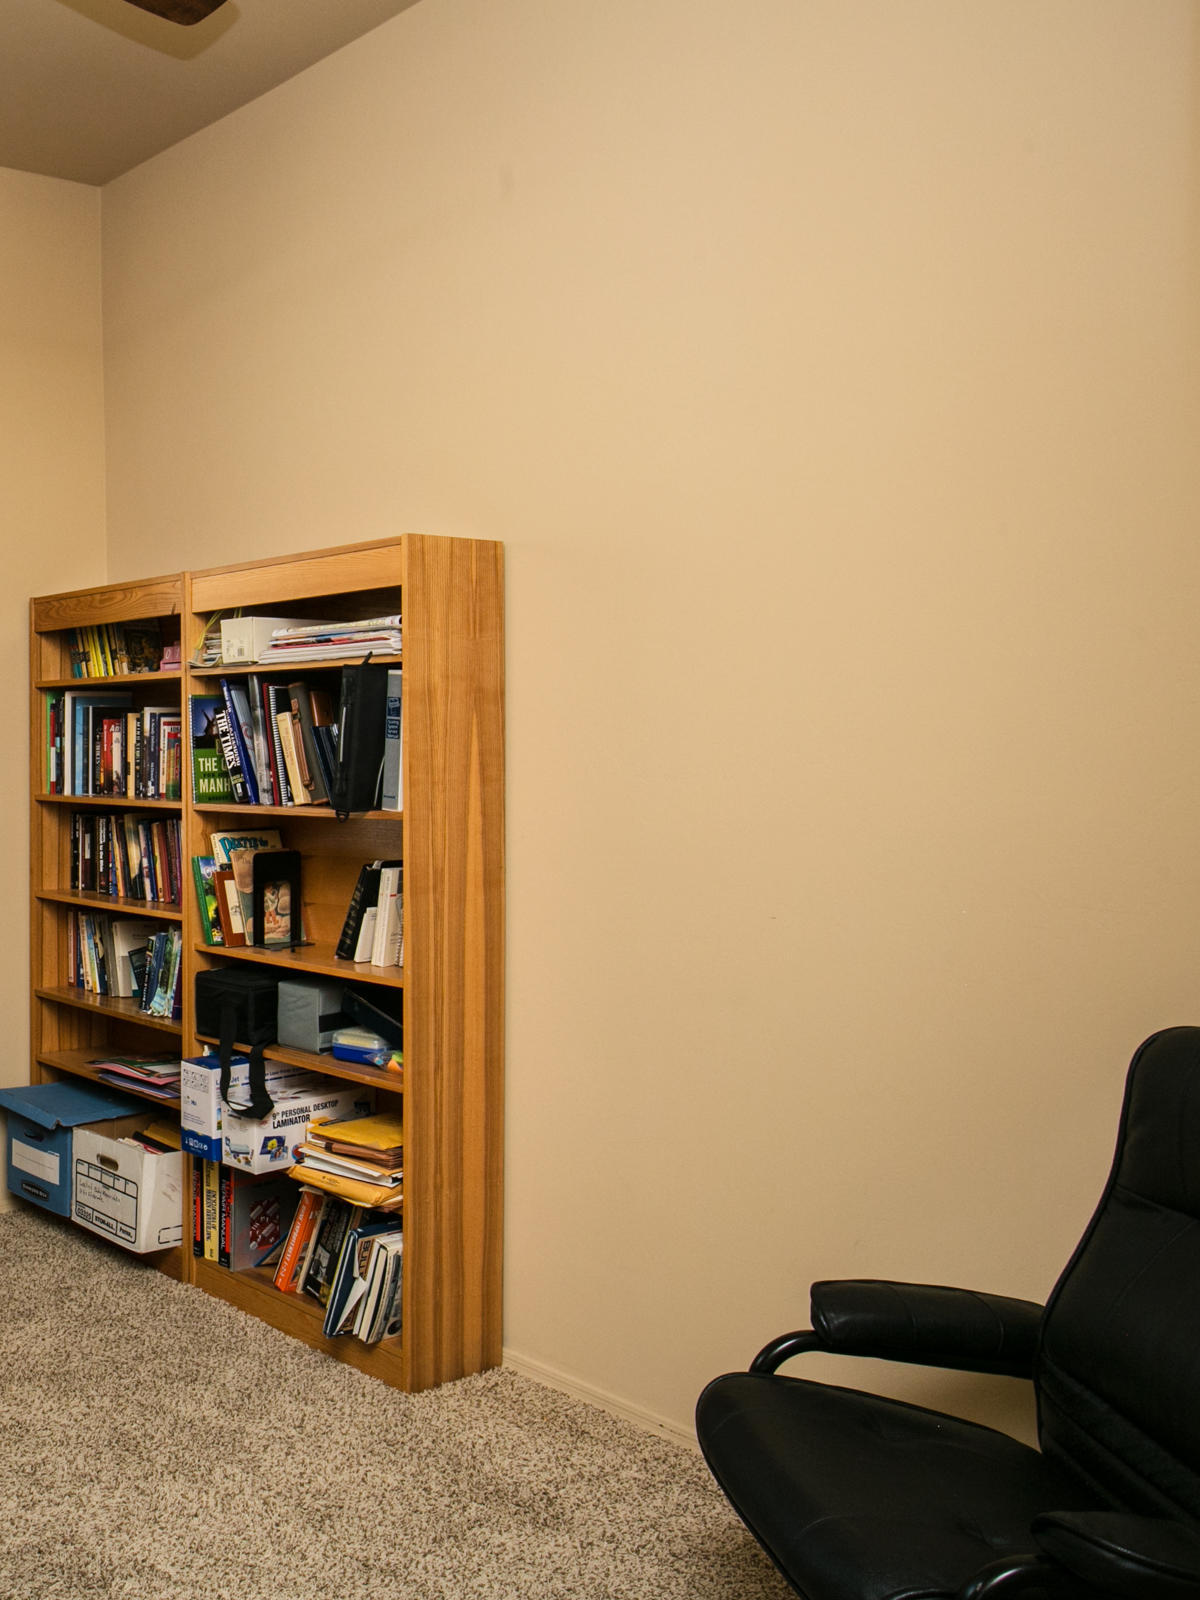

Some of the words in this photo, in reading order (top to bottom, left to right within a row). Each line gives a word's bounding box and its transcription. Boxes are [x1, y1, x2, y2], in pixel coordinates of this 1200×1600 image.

[216, 710, 230, 735] THE
[220, 732, 237, 769] TIMES
[198, 757, 218, 772] THE
[199, 778, 231, 793] MANH
[281, 1105, 312, 1119] PERSONAL
[312, 1099, 339, 1112] DESKTOP
[272, 1113, 311, 1129] LAMINATOR
